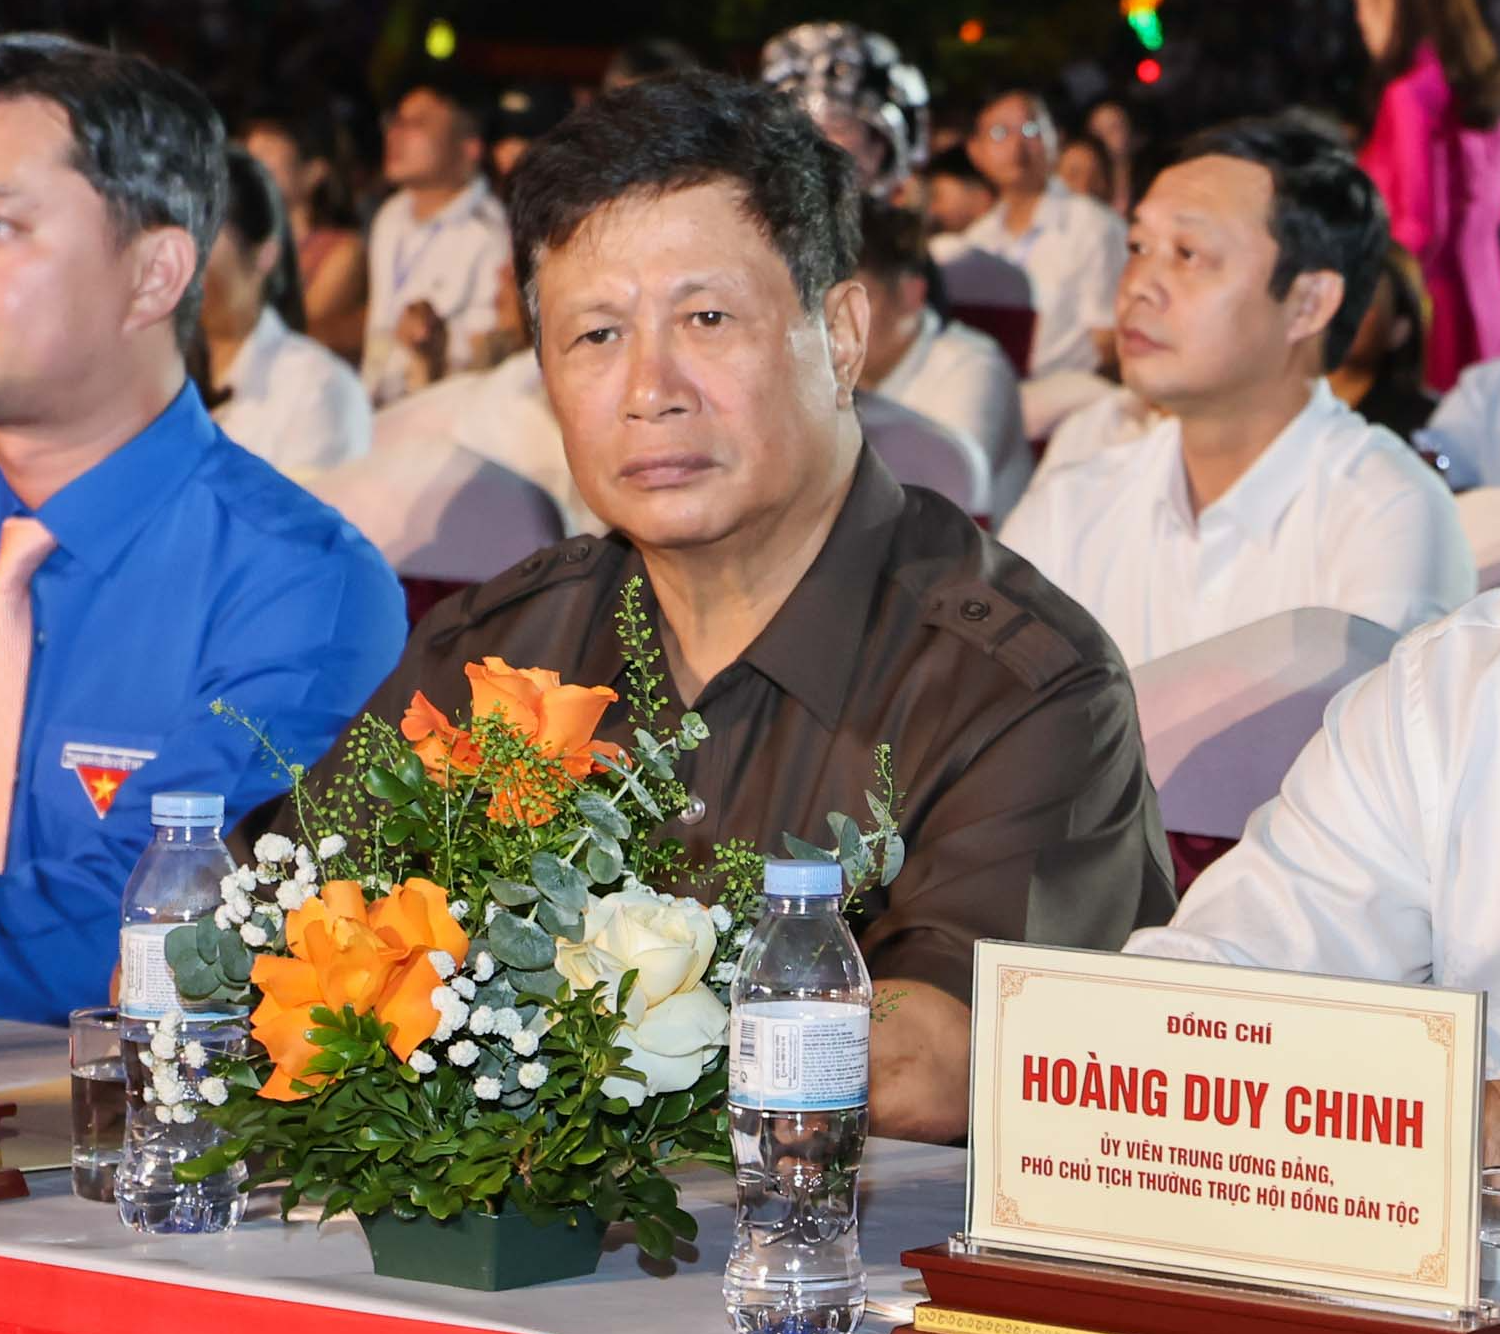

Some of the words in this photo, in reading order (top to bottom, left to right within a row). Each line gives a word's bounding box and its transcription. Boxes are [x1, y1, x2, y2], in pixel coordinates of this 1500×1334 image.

[1166, 1011, 1227, 1041] ĐỒNG
[1235, 1020, 1273, 1045] CHÍ
[1021, 1050, 1167, 1118] HOÀNG
[1184, 1072, 1269, 1129] DUY
[1284, 1086, 1424, 1148] CHINH
[1021, 1155, 1053, 1176] PHÓ
[1059, 1157, 1091, 1181] CHỦ
[1097, 1165, 1132, 1189] TỊCH
[1137, 1171, 1202, 1197] THƯỜNG
[1207, 1180, 1250, 1206] TRỰC
[1257, 1185, 1285, 1211] HỘI
[1291, 1186, 1338, 1214] ĐỒNG
[1345, 1196, 1380, 1220] DÂN
[1387, 1200, 1419, 1227] TỘC
[1100, 1132, 1121, 1156] ỦY
[1126, 1140, 1163, 1162] VIÊN
[1168, 1146, 1223, 1171] TRUNG
[1229, 1153, 1275, 1177] ƯƠNG
[1282, 1156, 1334, 1187] ĐẢNG,
